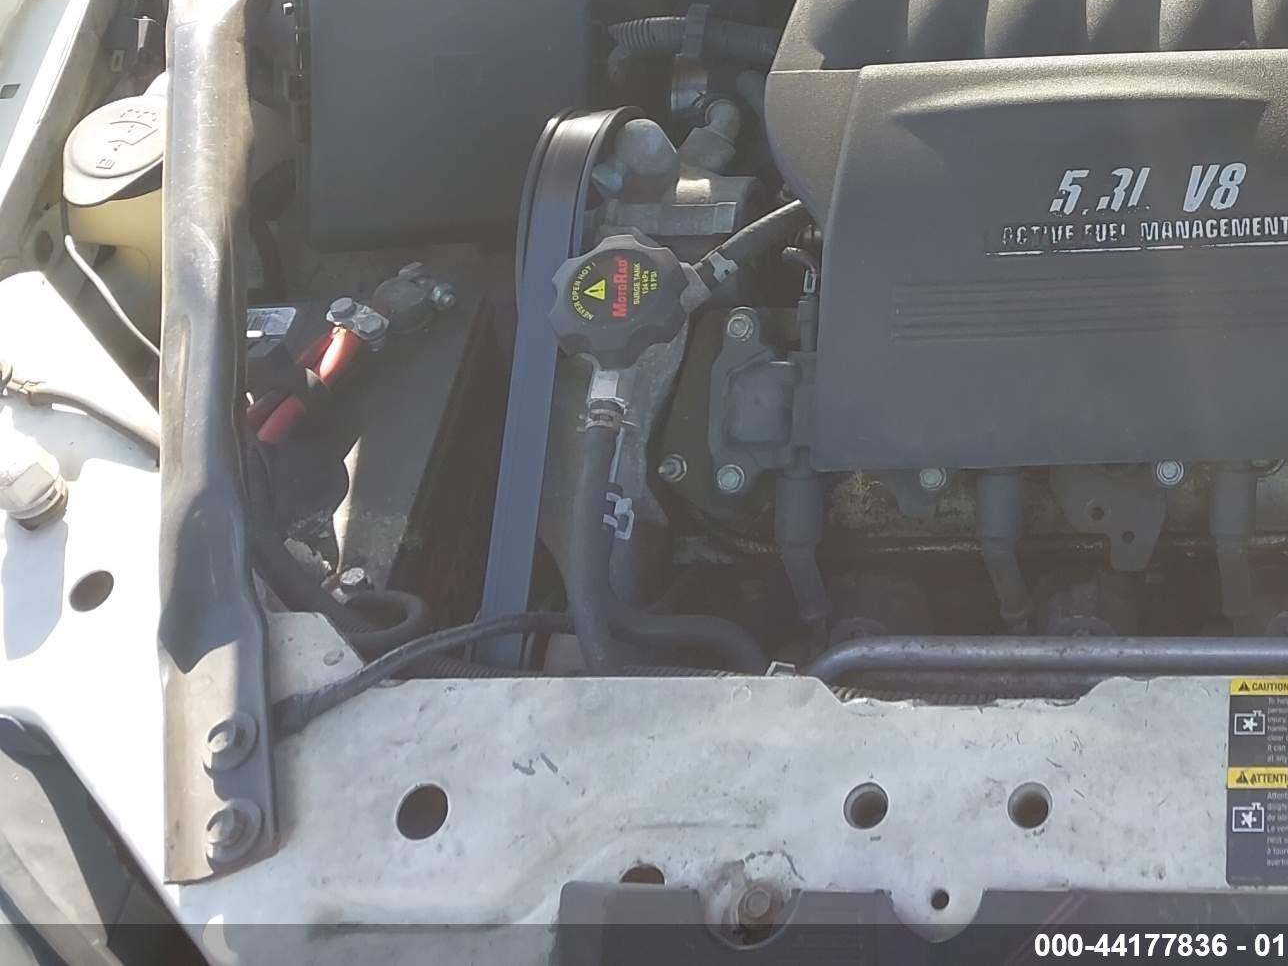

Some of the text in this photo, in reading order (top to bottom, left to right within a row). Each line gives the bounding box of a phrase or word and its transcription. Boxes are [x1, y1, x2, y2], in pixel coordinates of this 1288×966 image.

[1183, 163, 1247, 212] V8
[571, 279, 581, 301] OPEN
[1252, 683, 1288, 691] CAUTION
